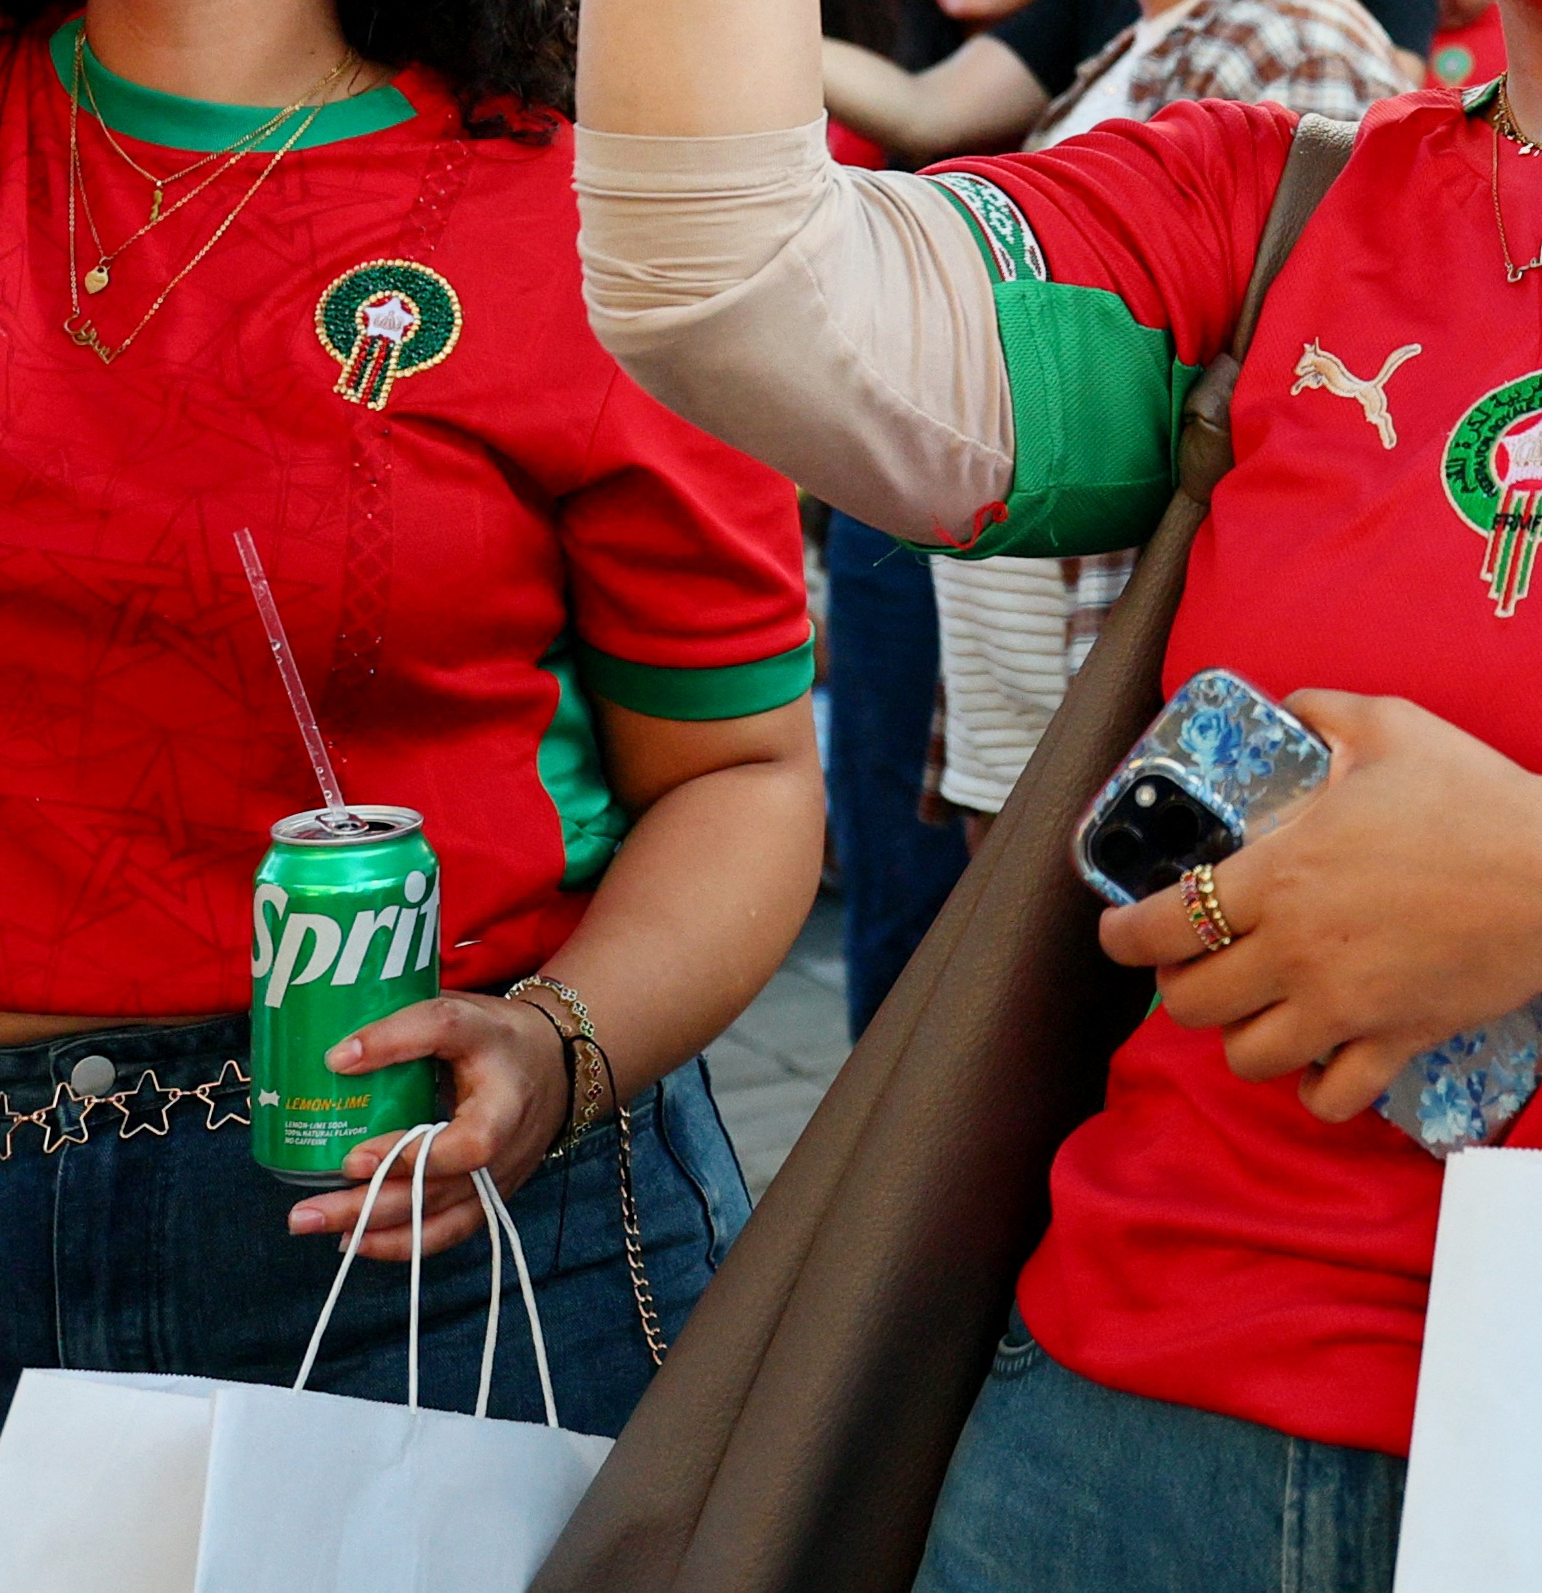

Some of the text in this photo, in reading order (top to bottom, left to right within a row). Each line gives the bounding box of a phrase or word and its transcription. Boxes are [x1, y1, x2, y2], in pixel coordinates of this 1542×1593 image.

[251, 866, 440, 1009] Sprit
[285, 1095, 372, 1112] LEMON-LIME
[285, 1121, 348, 1129] LEMON-LIME SODA
[302, 1129, 334, 1138] NATURAL
[334, 1126, 367, 1137] FLAVORS
